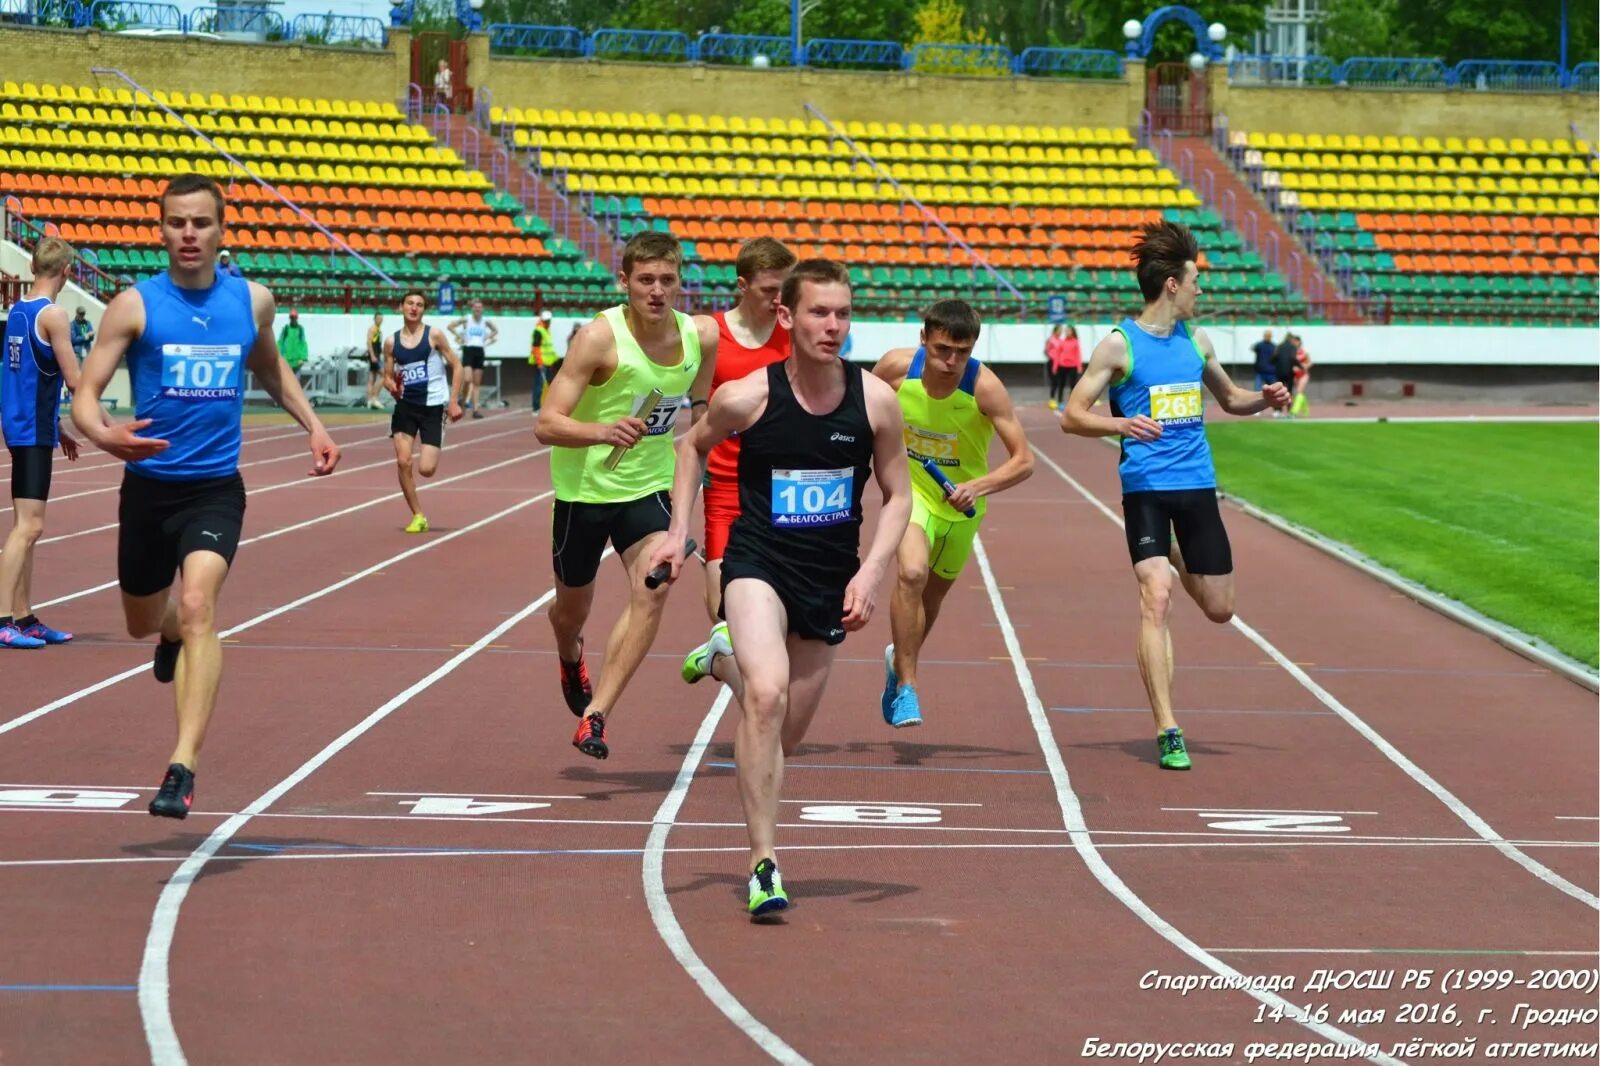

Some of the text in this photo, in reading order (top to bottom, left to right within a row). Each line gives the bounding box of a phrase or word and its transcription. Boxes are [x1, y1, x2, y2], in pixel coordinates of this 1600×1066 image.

[169, 360, 235, 387] 107
[402, 366, 426, 382] 305
[178, 387, 237, 399] БЕЛГОССТРАХ
[1156, 394, 1200, 418] 265
[779, 485, 847, 513] 104
[790, 509, 851, 524] БЕЛГОССТРАХ
